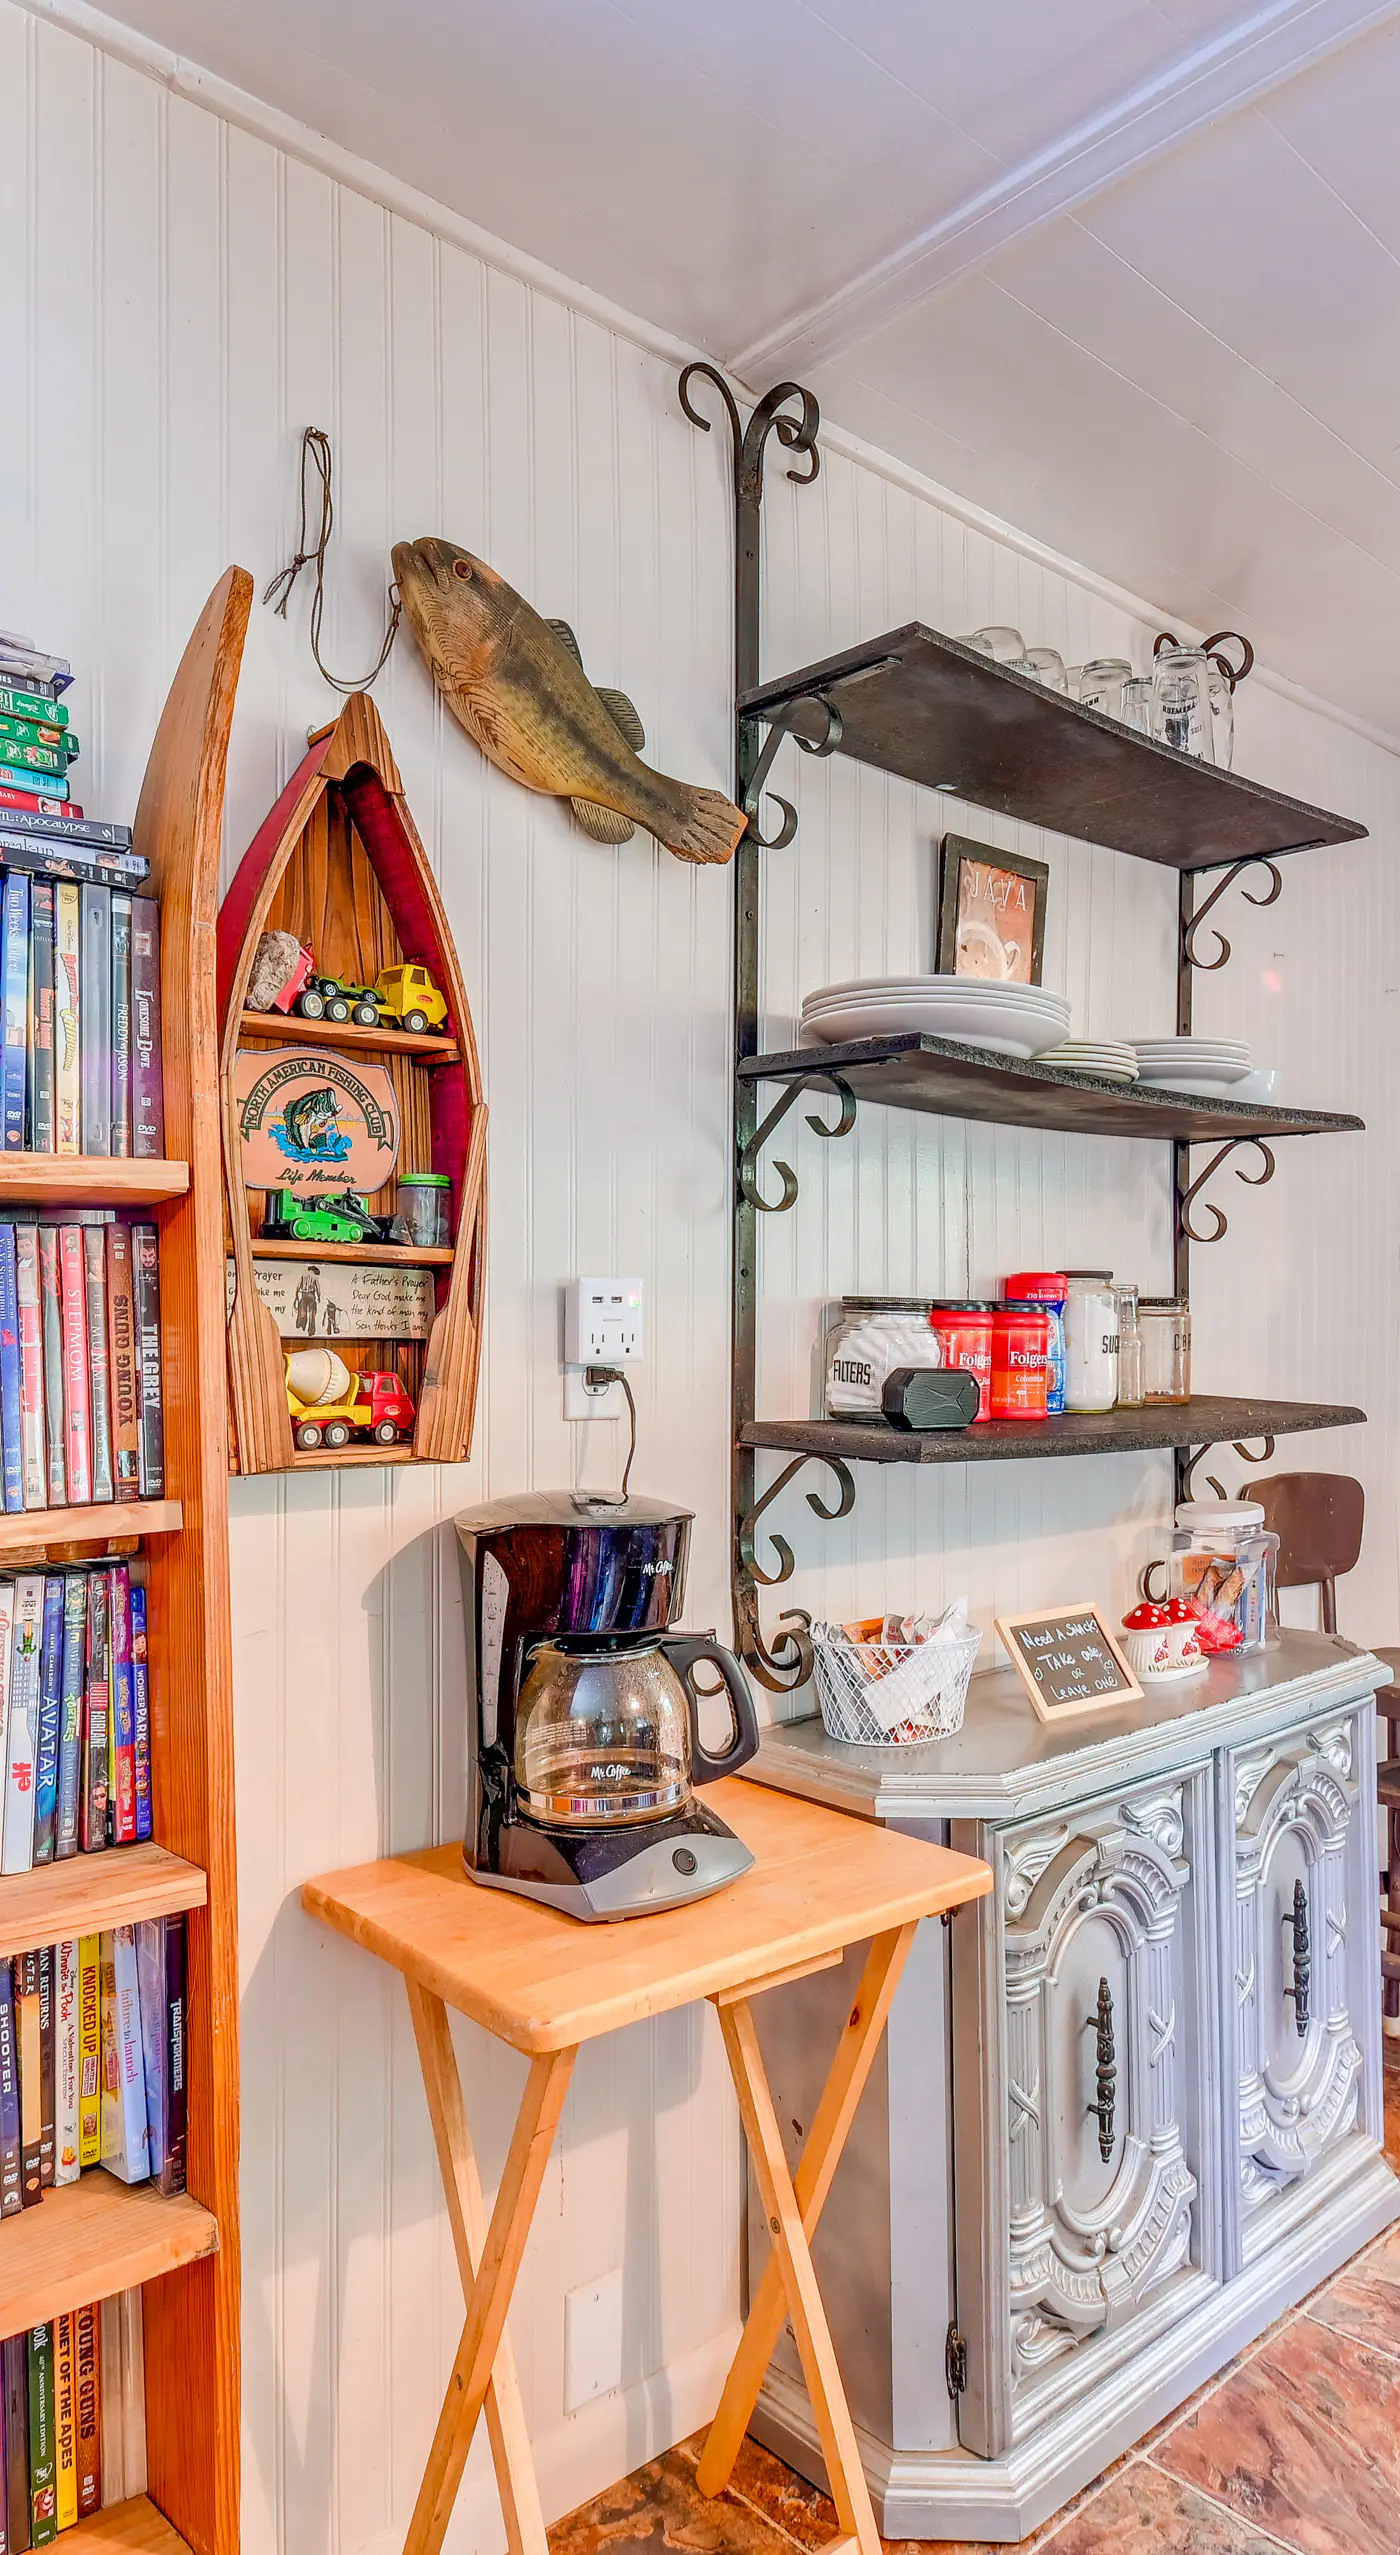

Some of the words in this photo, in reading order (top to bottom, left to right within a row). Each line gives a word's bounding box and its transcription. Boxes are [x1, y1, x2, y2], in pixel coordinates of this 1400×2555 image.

[8, 888, 24, 907] Two
[969, 871, 1027, 912] JAVA
[117, 1003, 129, 1043] FREDDY
[134, 987, 154, 1037] LONESOME
[114, 1048, 129, 1082] JASON
[137, 1034, 153, 1069] DOVE
[246, 1085, 270, 1126] NORTH
[267, 1061, 326, 1089] AMERICAN
[328, 1066, 368, 1103] FISHING
[364, 1102, 383, 1135] CLUB
[138, 1124, 156, 1133] DVD
[276, 1168, 304, 1184] Life
[306, 1169, 357, 1185] Member
[352, 1290, 371, 1300] Dear
[373, 1290, 391, 1302] God
[393, 1292, 413, 1302] make
[362, 1273, 398, 1286] Father's
[402, 1275, 428, 1294] Prayer
[93, 1293, 101, 1319] THE
[114, 1294, 130, 1349] GUNS
[366, 1305, 385, 1316] kind
[387, 1305, 397, 1316] of
[67, 1289, 82, 1382] STEPMOM
[141, 1323, 158, 1359] THE
[356, 1320, 371, 1331] Son
[373, 1320, 398, 1331] thinks
[401, 1320, 410, 1331] I
[91, 1326, 107, 1392] MUMMY
[833, 1360, 871, 1385] FILTERS
[959, 1352, 992, 1369] Folgers
[1010, 1351, 1047, 1368] Folgers
[116, 1353, 133, 1427] YOUNG
[143, 1361, 160, 1409] GREY
[96, 1400, 106, 1464] TRILOGY
[1020, 1629, 1054, 1650] Need
[1056, 1628, 1066, 1641] A
[1071, 1667, 1085, 1679] OR
[62, 1692, 79, 1742] TURTLES
[90, 1711, 107, 1749] FAIRLANE
[37, 1695, 58, 1791] AVATAR
[12, 1762, 32, 1792] elf
[591, 1766, 605, 1780] Mr.
[606, 1764, 631, 1781] Coffee
[25, 1950, 35, 1996] ISTER
[60, 1941, 73, 1981] Winnie
[40, 1975, 49, 2030] RETURNS
[61, 1991, 74, 2022] Pooh
[82, 1966, 96, 2032] KNOCKED
[120, 1988, 134, 2029] failure
[68, 2023, 74, 2031] A
[83, 2036, 97, 2053] UP
[123, 2030, 131, 2040] to
[169, 1997, 182, 2092] TRANSFORMERS
[0, 2003, 12, 2094] SHOOTER
[67, 2031, 75, 2073] Valentine
[124, 2039, 139, 2083] launch
[67, 2094, 75, 2110] You
[59, 2314, 71, 2357] ANET
[78, 2306, 95, 2376] YOUNG
[60, 2361, 71, 2383] OF
[38, 2371, 46, 2422] ANNIVERSARY
[60, 2385, 72, 2421] THE
[79, 2381, 96, 2440] GUNS
[39, 2423, 47, 2457] EDITION
[58, 2424, 73, 2470] APES
